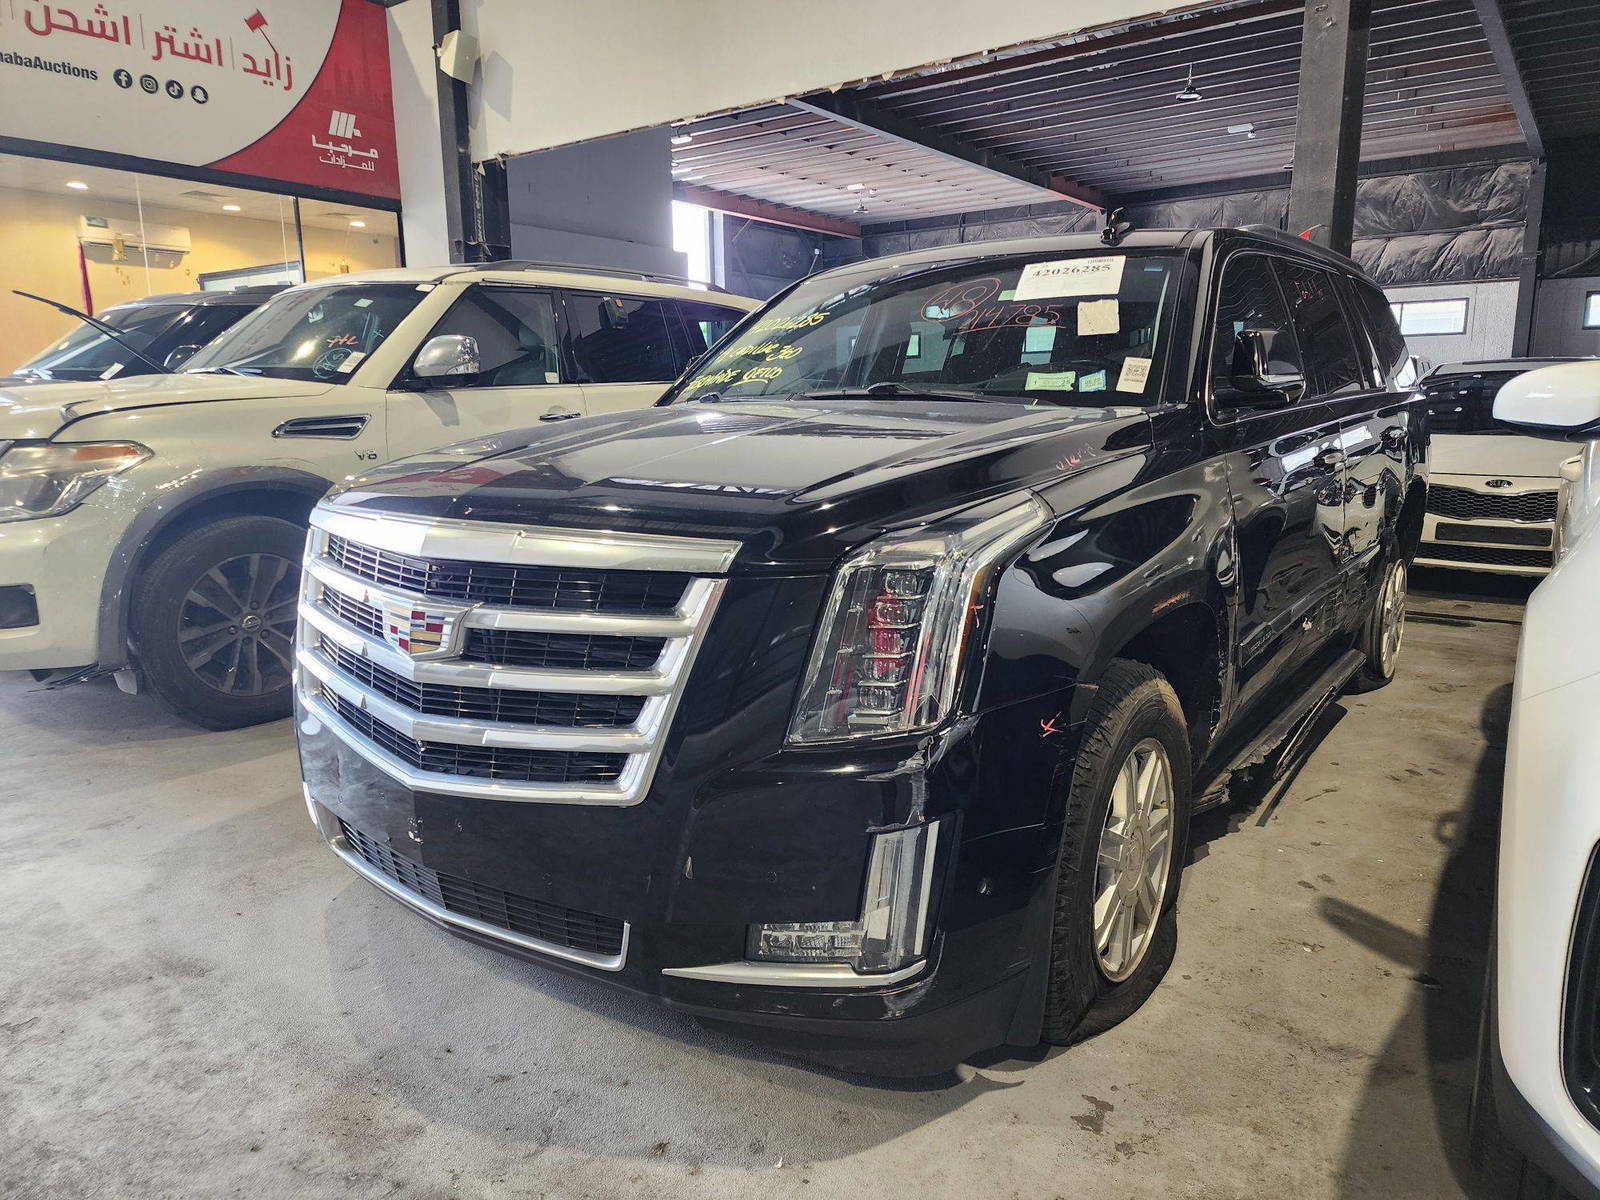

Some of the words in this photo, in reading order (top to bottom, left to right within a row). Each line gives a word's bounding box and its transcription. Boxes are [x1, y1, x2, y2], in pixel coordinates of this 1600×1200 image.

[25, 0, 131, 45] اشحن
[152, 25, 223, 66] اشتر
[243, 51, 293, 91] زايد
[312, 134, 378, 158] مرحبا
[320, 154, 375, 171] للمزادات
[1032, 264, 1111, 277] 42026285
